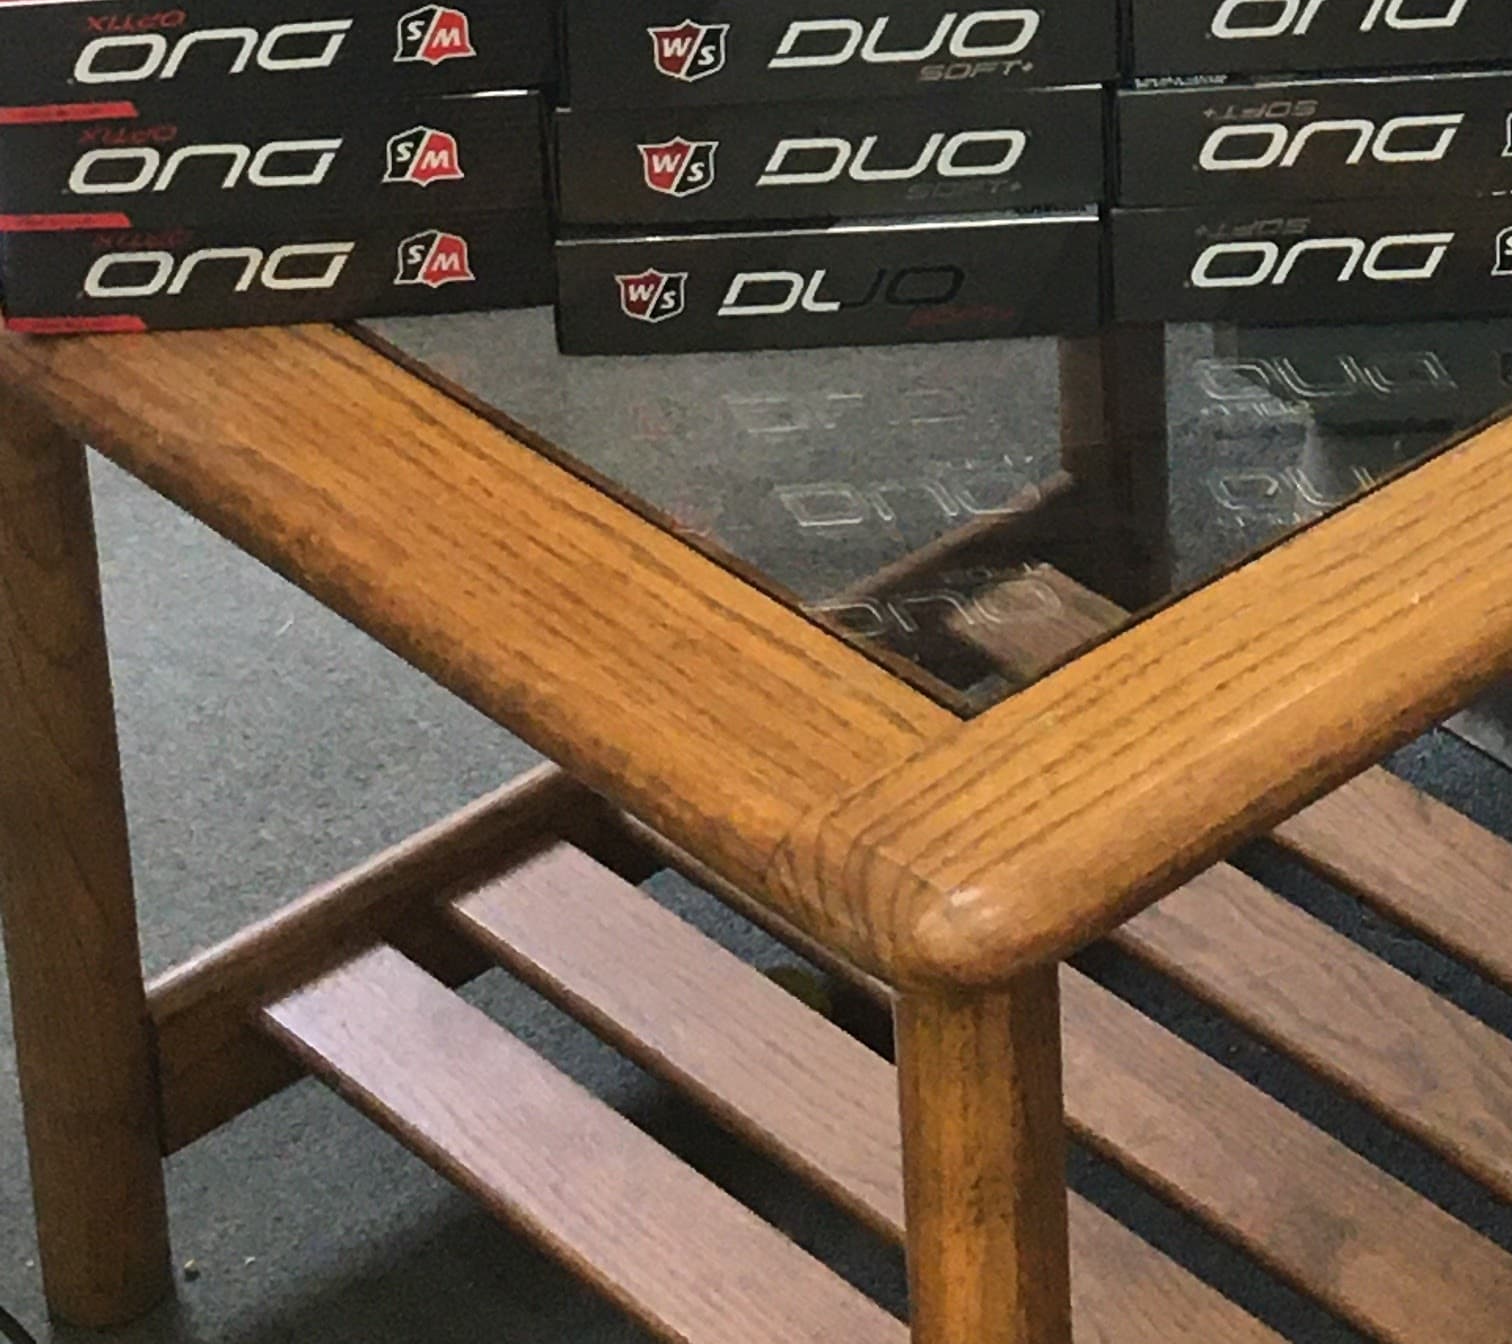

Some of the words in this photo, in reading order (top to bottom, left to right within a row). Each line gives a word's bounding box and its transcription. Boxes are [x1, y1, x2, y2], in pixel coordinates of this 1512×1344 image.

[86, 10, 187, 32] OPTIX
[767, 8, 1042, 71] DUO
[74, 18, 354, 85] DUO
[68, 137, 344, 195] DUO
[755, 129, 1028, 188] DUO
[1198, 113, 1465, 172] DUO
[82, 240, 356, 298] DUO
[1189, 231, 1456, 289] DUO
